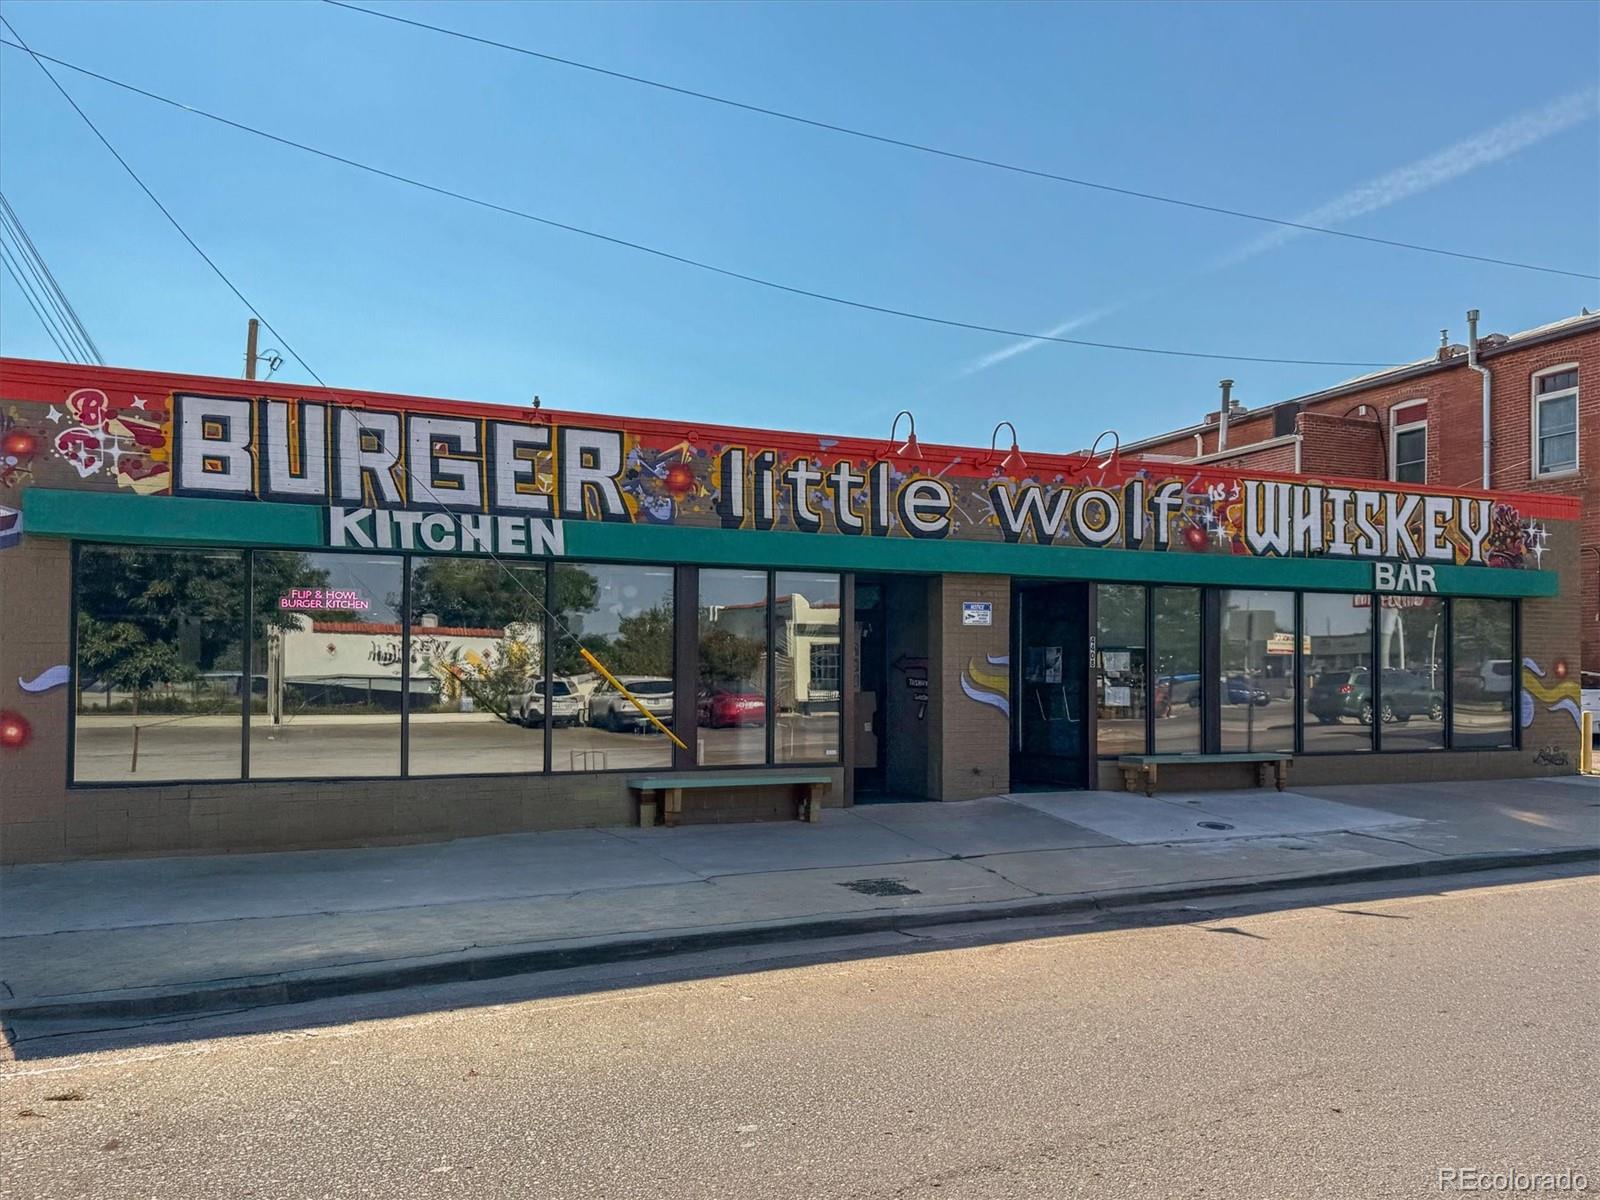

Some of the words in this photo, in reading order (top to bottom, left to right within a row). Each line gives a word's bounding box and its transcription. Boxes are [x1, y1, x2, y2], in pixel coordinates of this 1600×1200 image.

[177, 394, 626, 520] BURGER
[720, 446, 951, 538] little
[992, 478, 1184, 551] wolf
[1242, 480, 1494, 564] WHISKEY
[330, 507, 565, 556] KITCHEN
[291, 589, 313, 599] FLIP
[314, 590, 323, 599] &
[326, 590, 359, 600] HOWL
[1375, 561, 1437, 593] BAR
[281, 599, 323, 608] BURGER
[325, 599, 369, 609] KITCHEN
